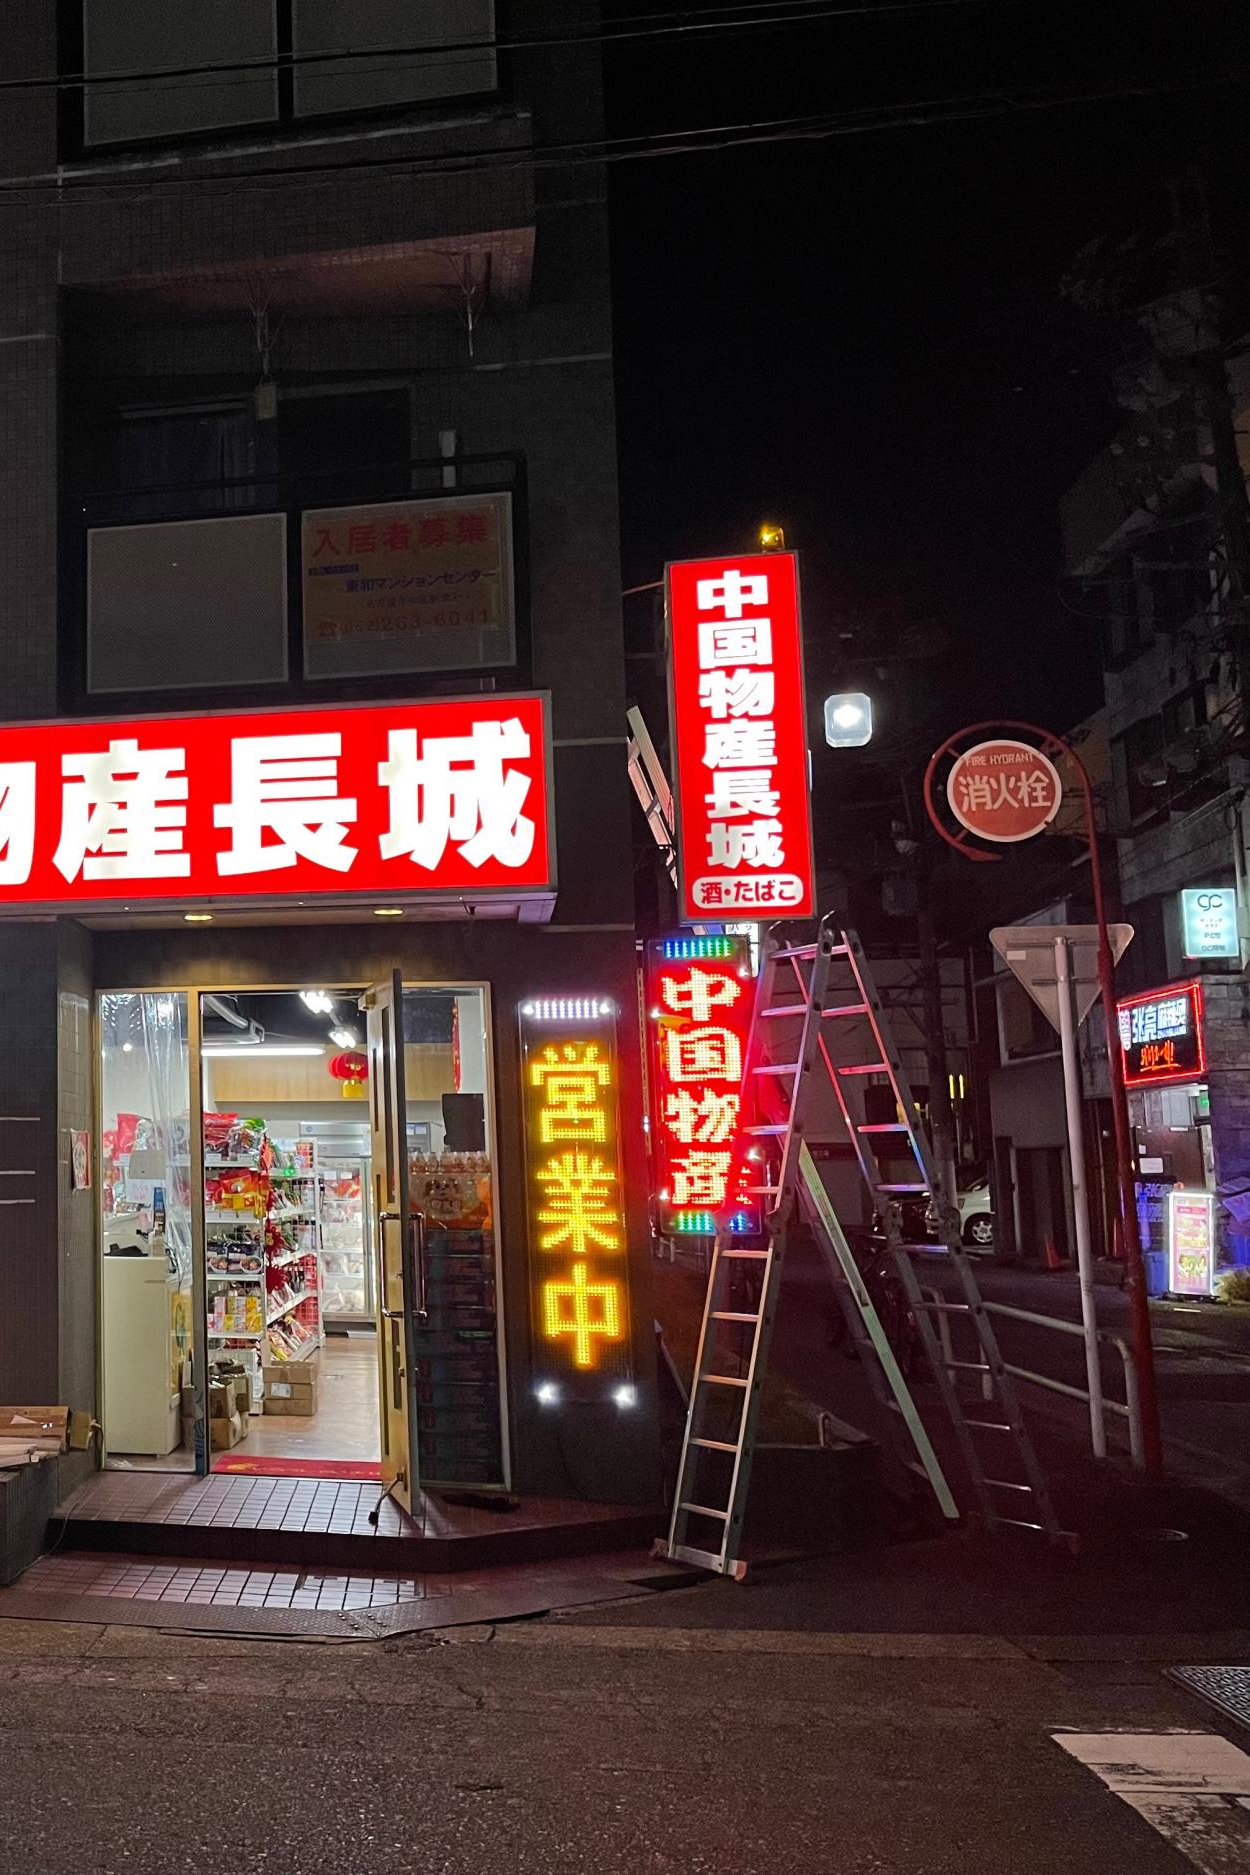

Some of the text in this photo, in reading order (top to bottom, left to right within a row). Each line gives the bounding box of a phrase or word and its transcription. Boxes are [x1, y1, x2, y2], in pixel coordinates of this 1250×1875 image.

[312, 514, 488, 557] 入居者募集
[345, 569, 495, 593] 東和マンションセンター
[696, 570, 785, 869] 中国物産長城
[965, 754, 1035, 767] FIRE HYDRANT
[958, 770, 1051, 812] 消火栓
[530, 1044, 620, 1366] 営業中
